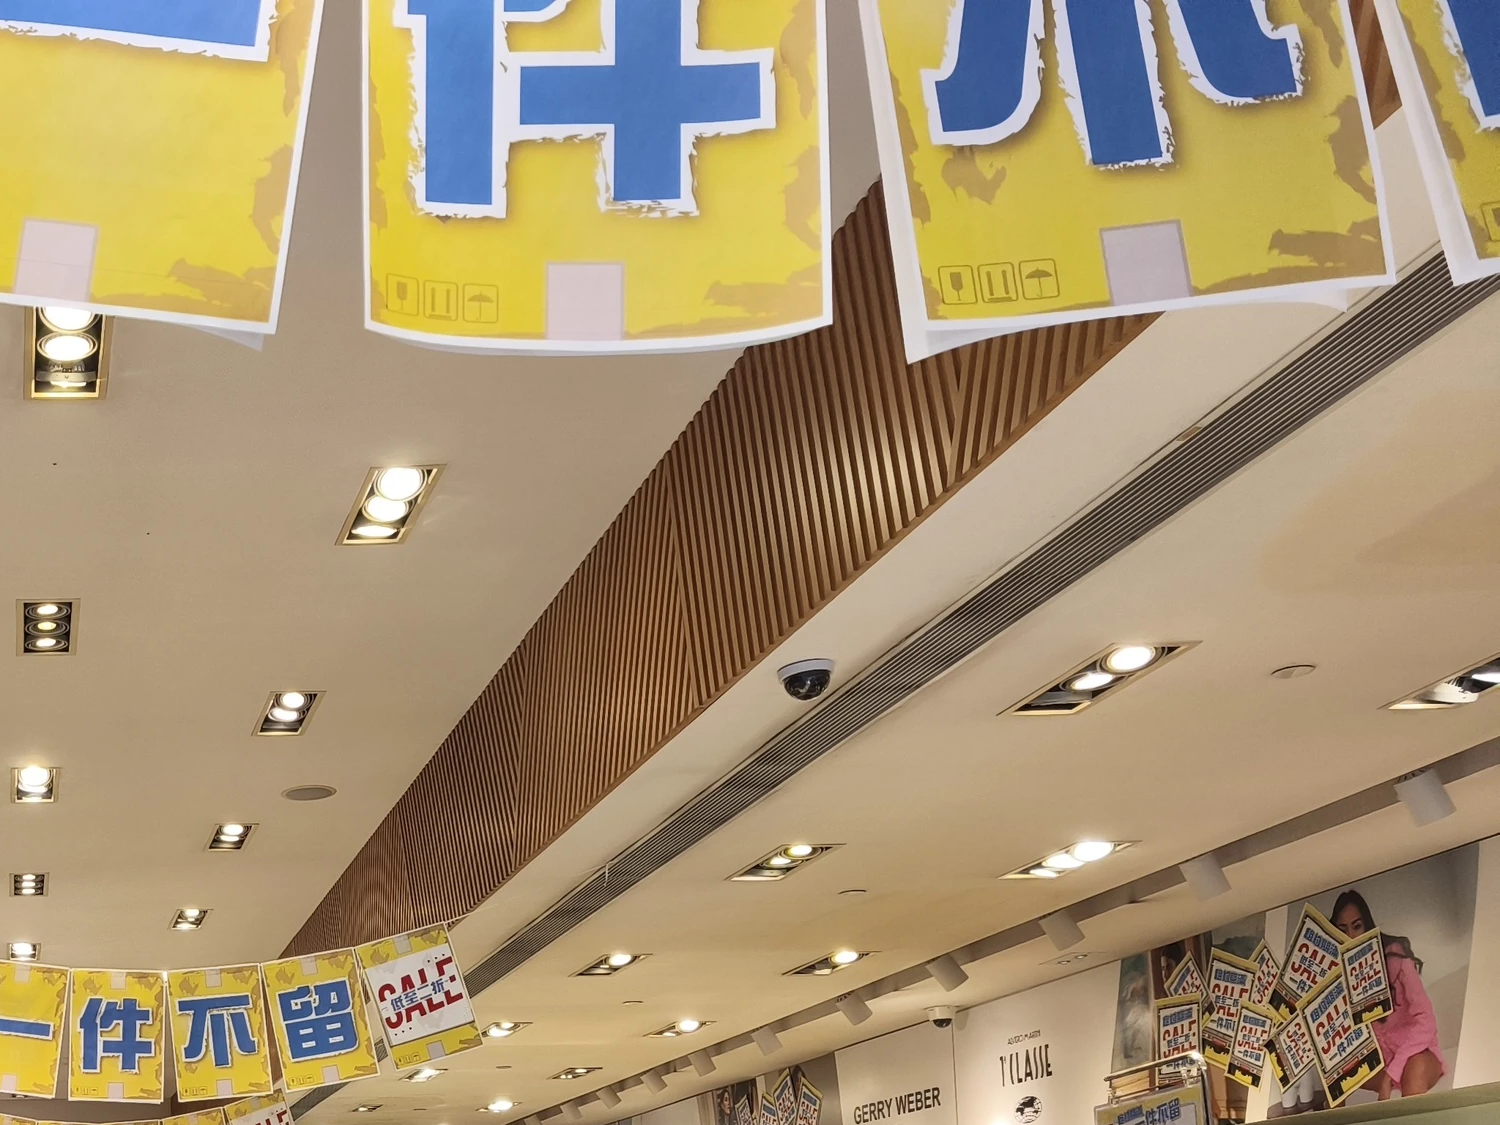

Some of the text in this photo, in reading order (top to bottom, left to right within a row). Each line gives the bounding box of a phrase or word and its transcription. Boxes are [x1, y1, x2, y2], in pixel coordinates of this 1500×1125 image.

[378, 957, 464, 1030] SALE
[390, 979, 447, 1010] 低至二折
[853, 1086, 942, 1125] GERRY WEBER
